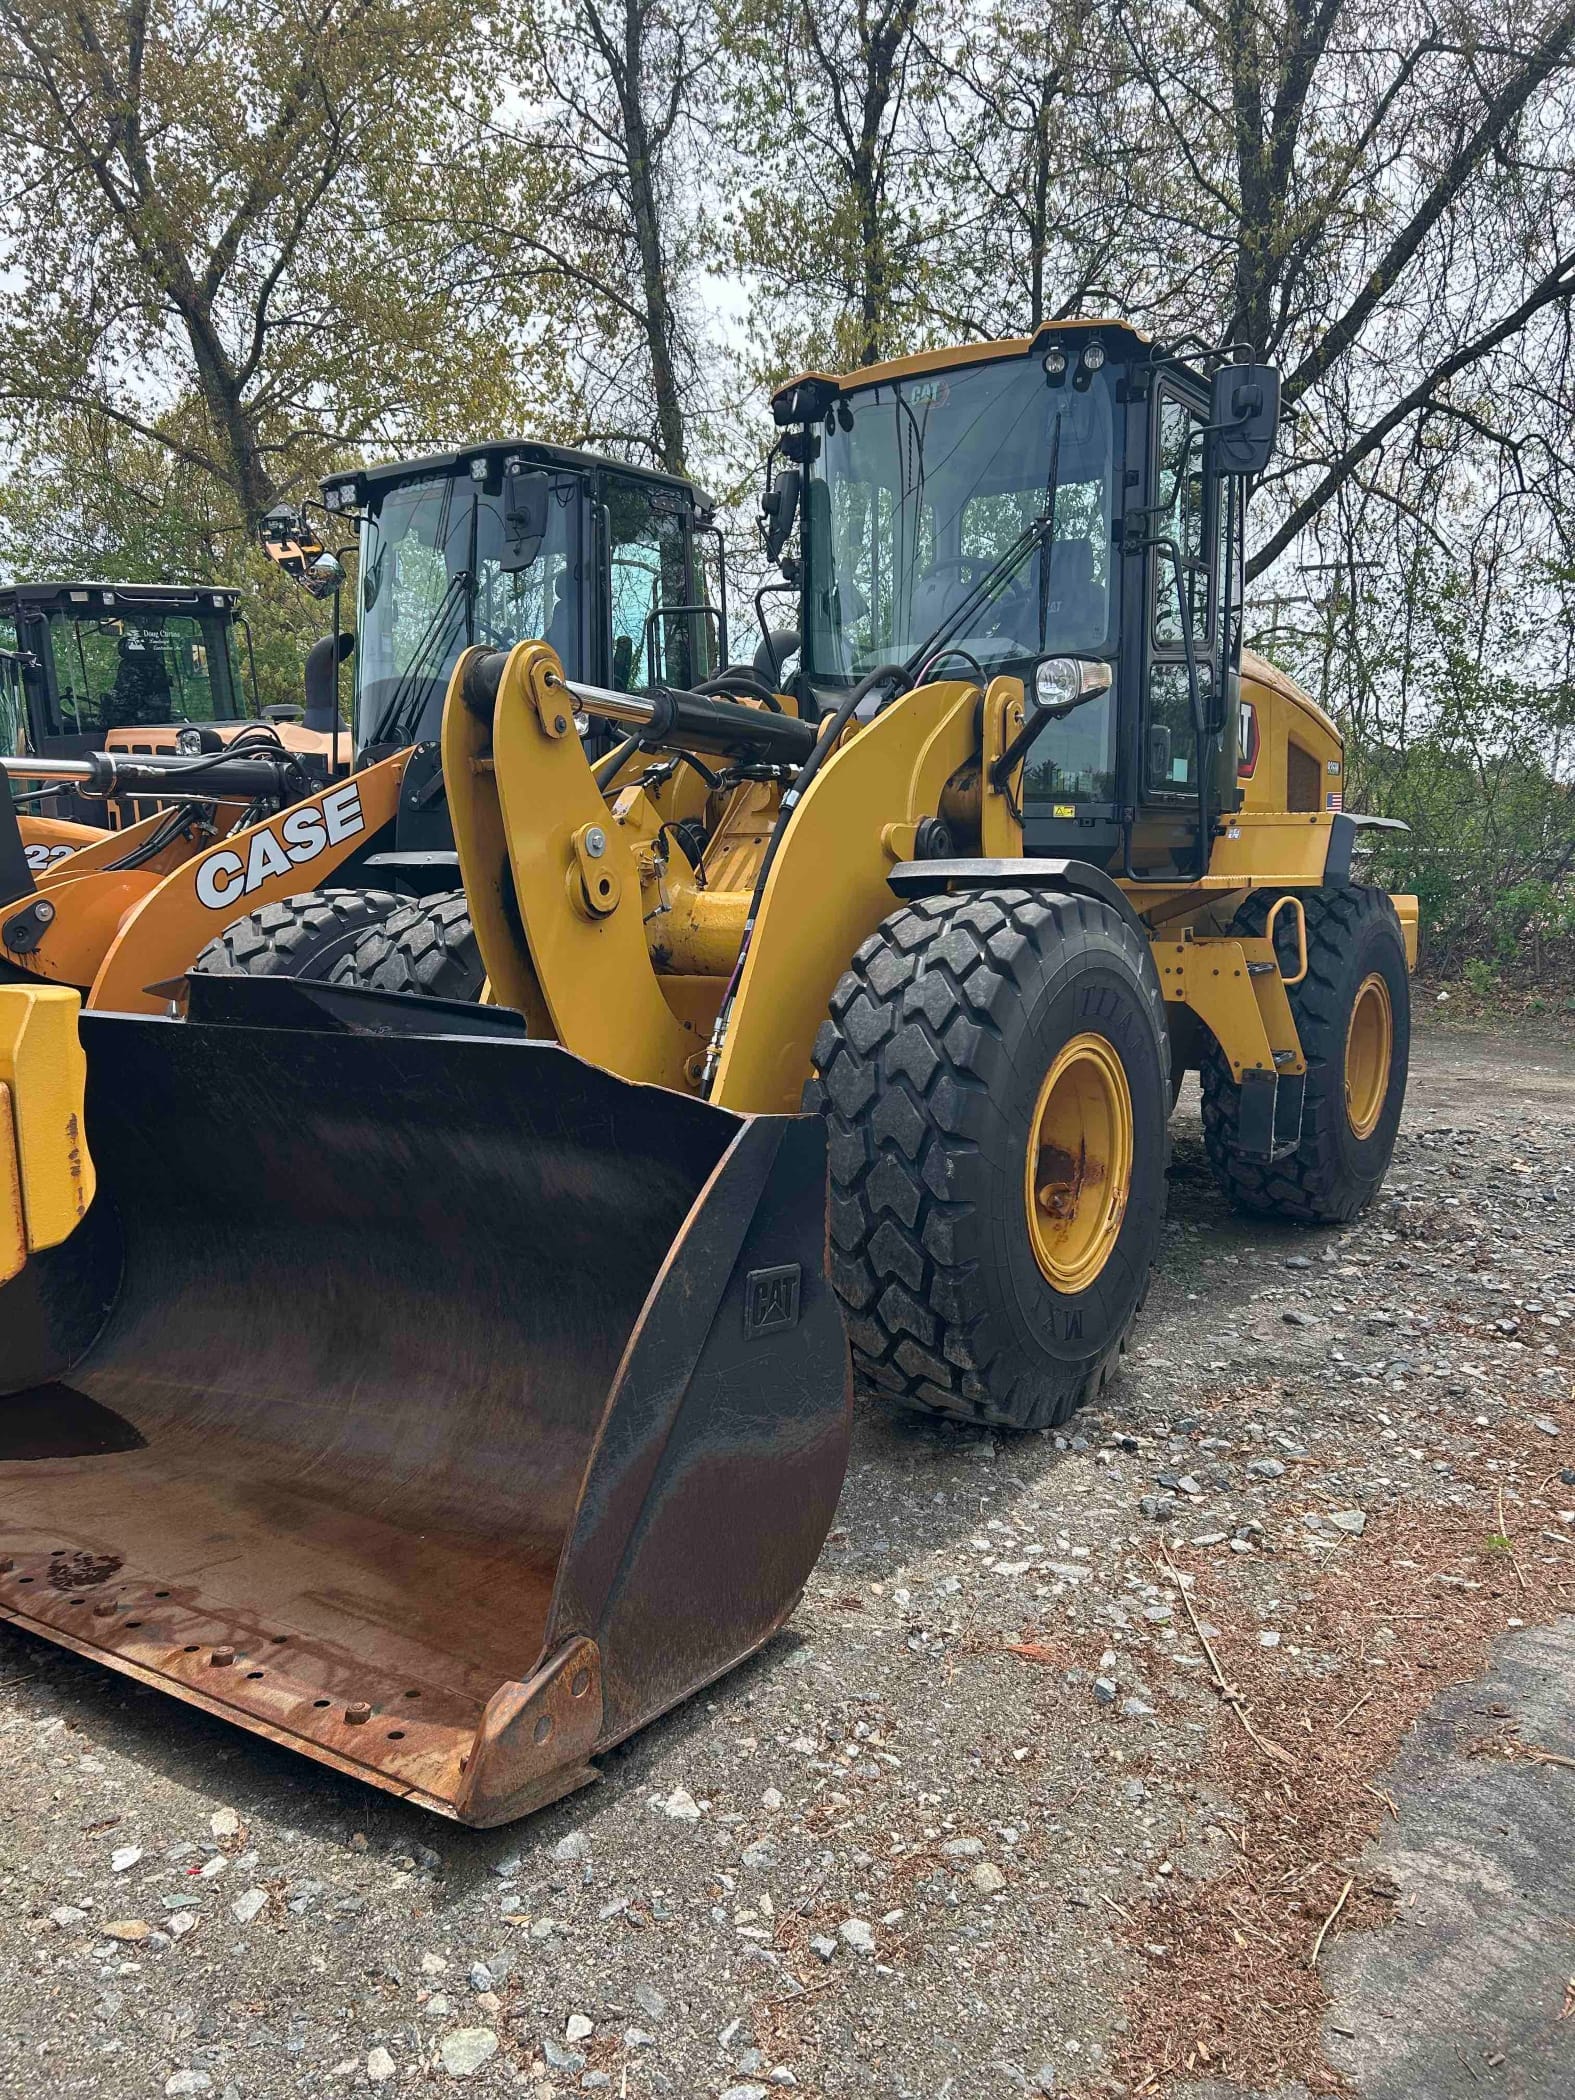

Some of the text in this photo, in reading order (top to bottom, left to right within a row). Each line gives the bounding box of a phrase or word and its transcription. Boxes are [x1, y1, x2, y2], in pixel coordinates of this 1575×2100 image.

[910, 382, 940, 406] CAT
[195, 781, 366, 910] CASE
[752, 1276, 798, 1328] CAT
